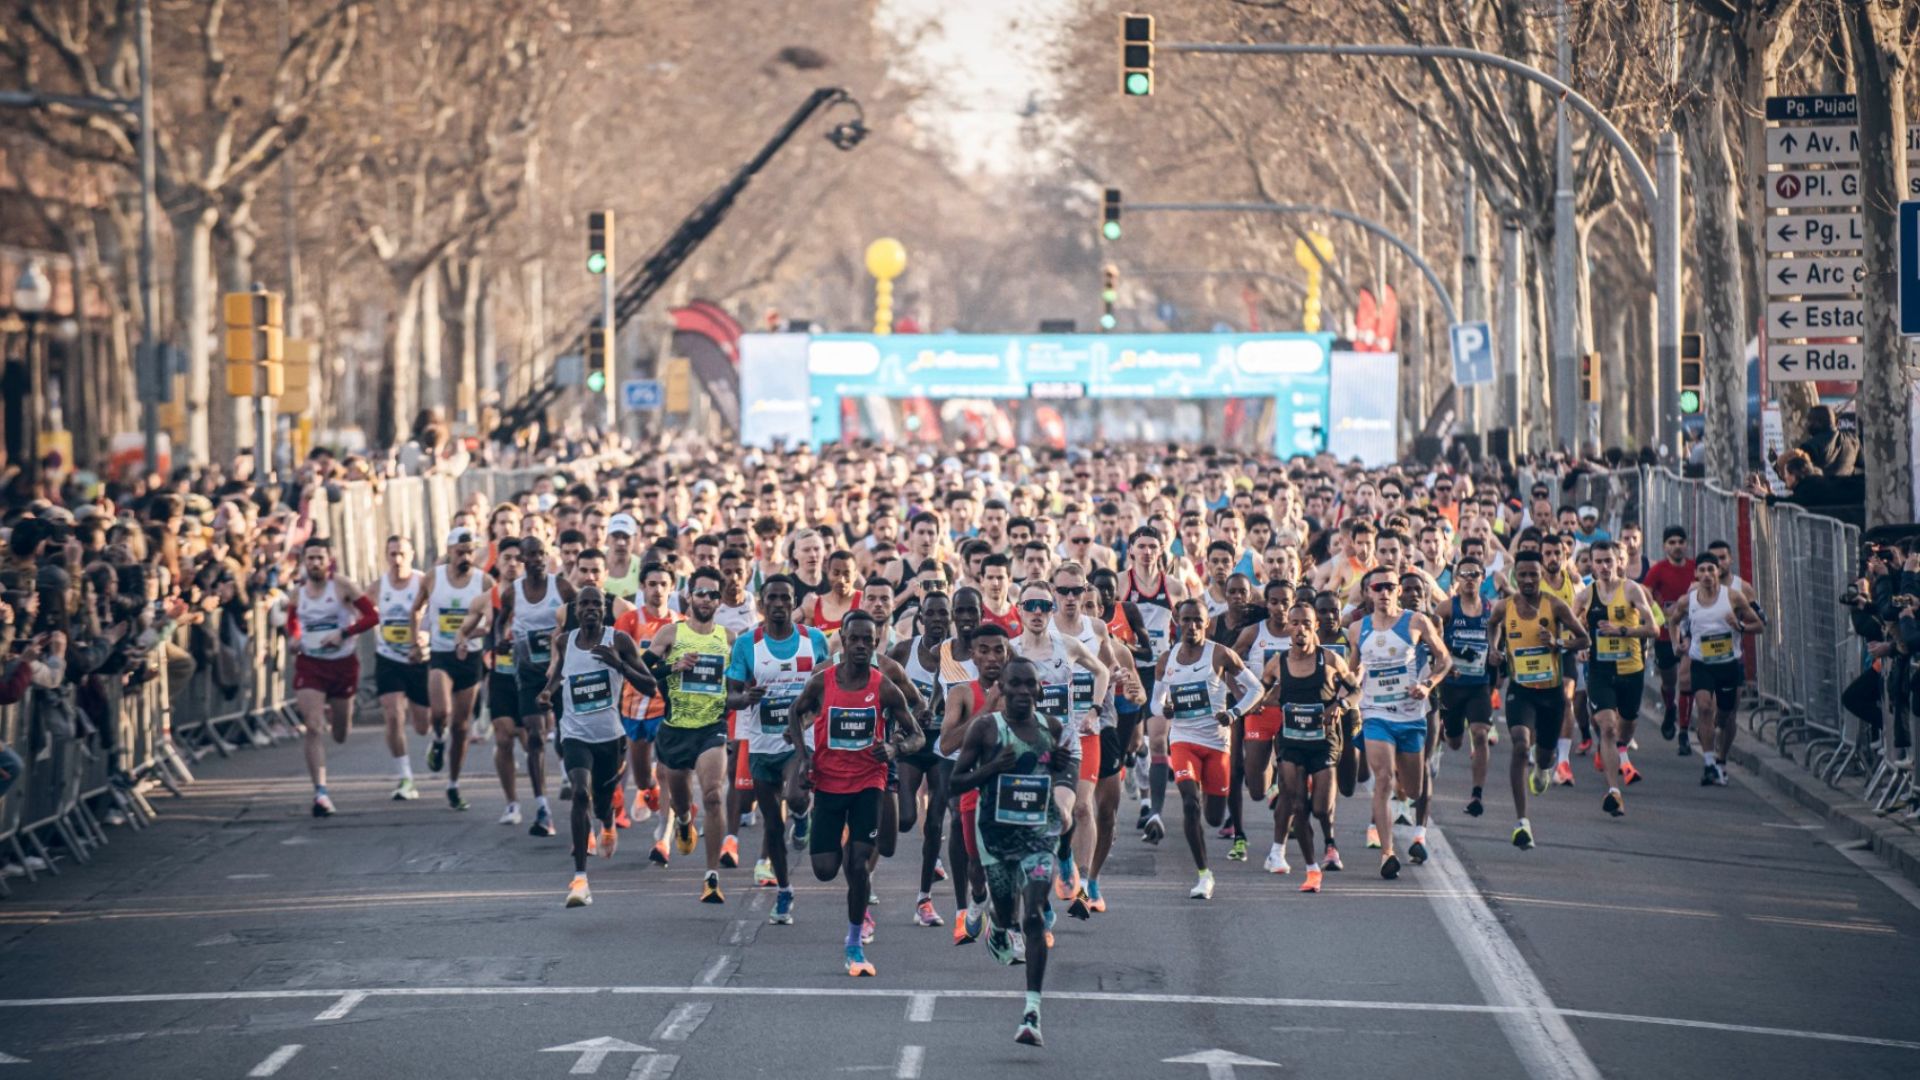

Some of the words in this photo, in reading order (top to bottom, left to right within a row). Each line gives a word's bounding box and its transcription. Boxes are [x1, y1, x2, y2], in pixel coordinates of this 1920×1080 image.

[1786, 99, 1809, 117] Pg.
[1815, 98, 1858, 116] Pujad
[1805, 131, 1840, 152] Av.
[1805, 175, 1832, 197] Pl.
[1805, 219, 1840, 245] Pg.
[1806, 263, 1844, 284] Arc
[1457, 329, 1484, 363] P
[1806, 350, 1856, 371] Rda.
[841, 720, 867, 731] LANGAT
[1013, 791, 1038, 802] PACER
